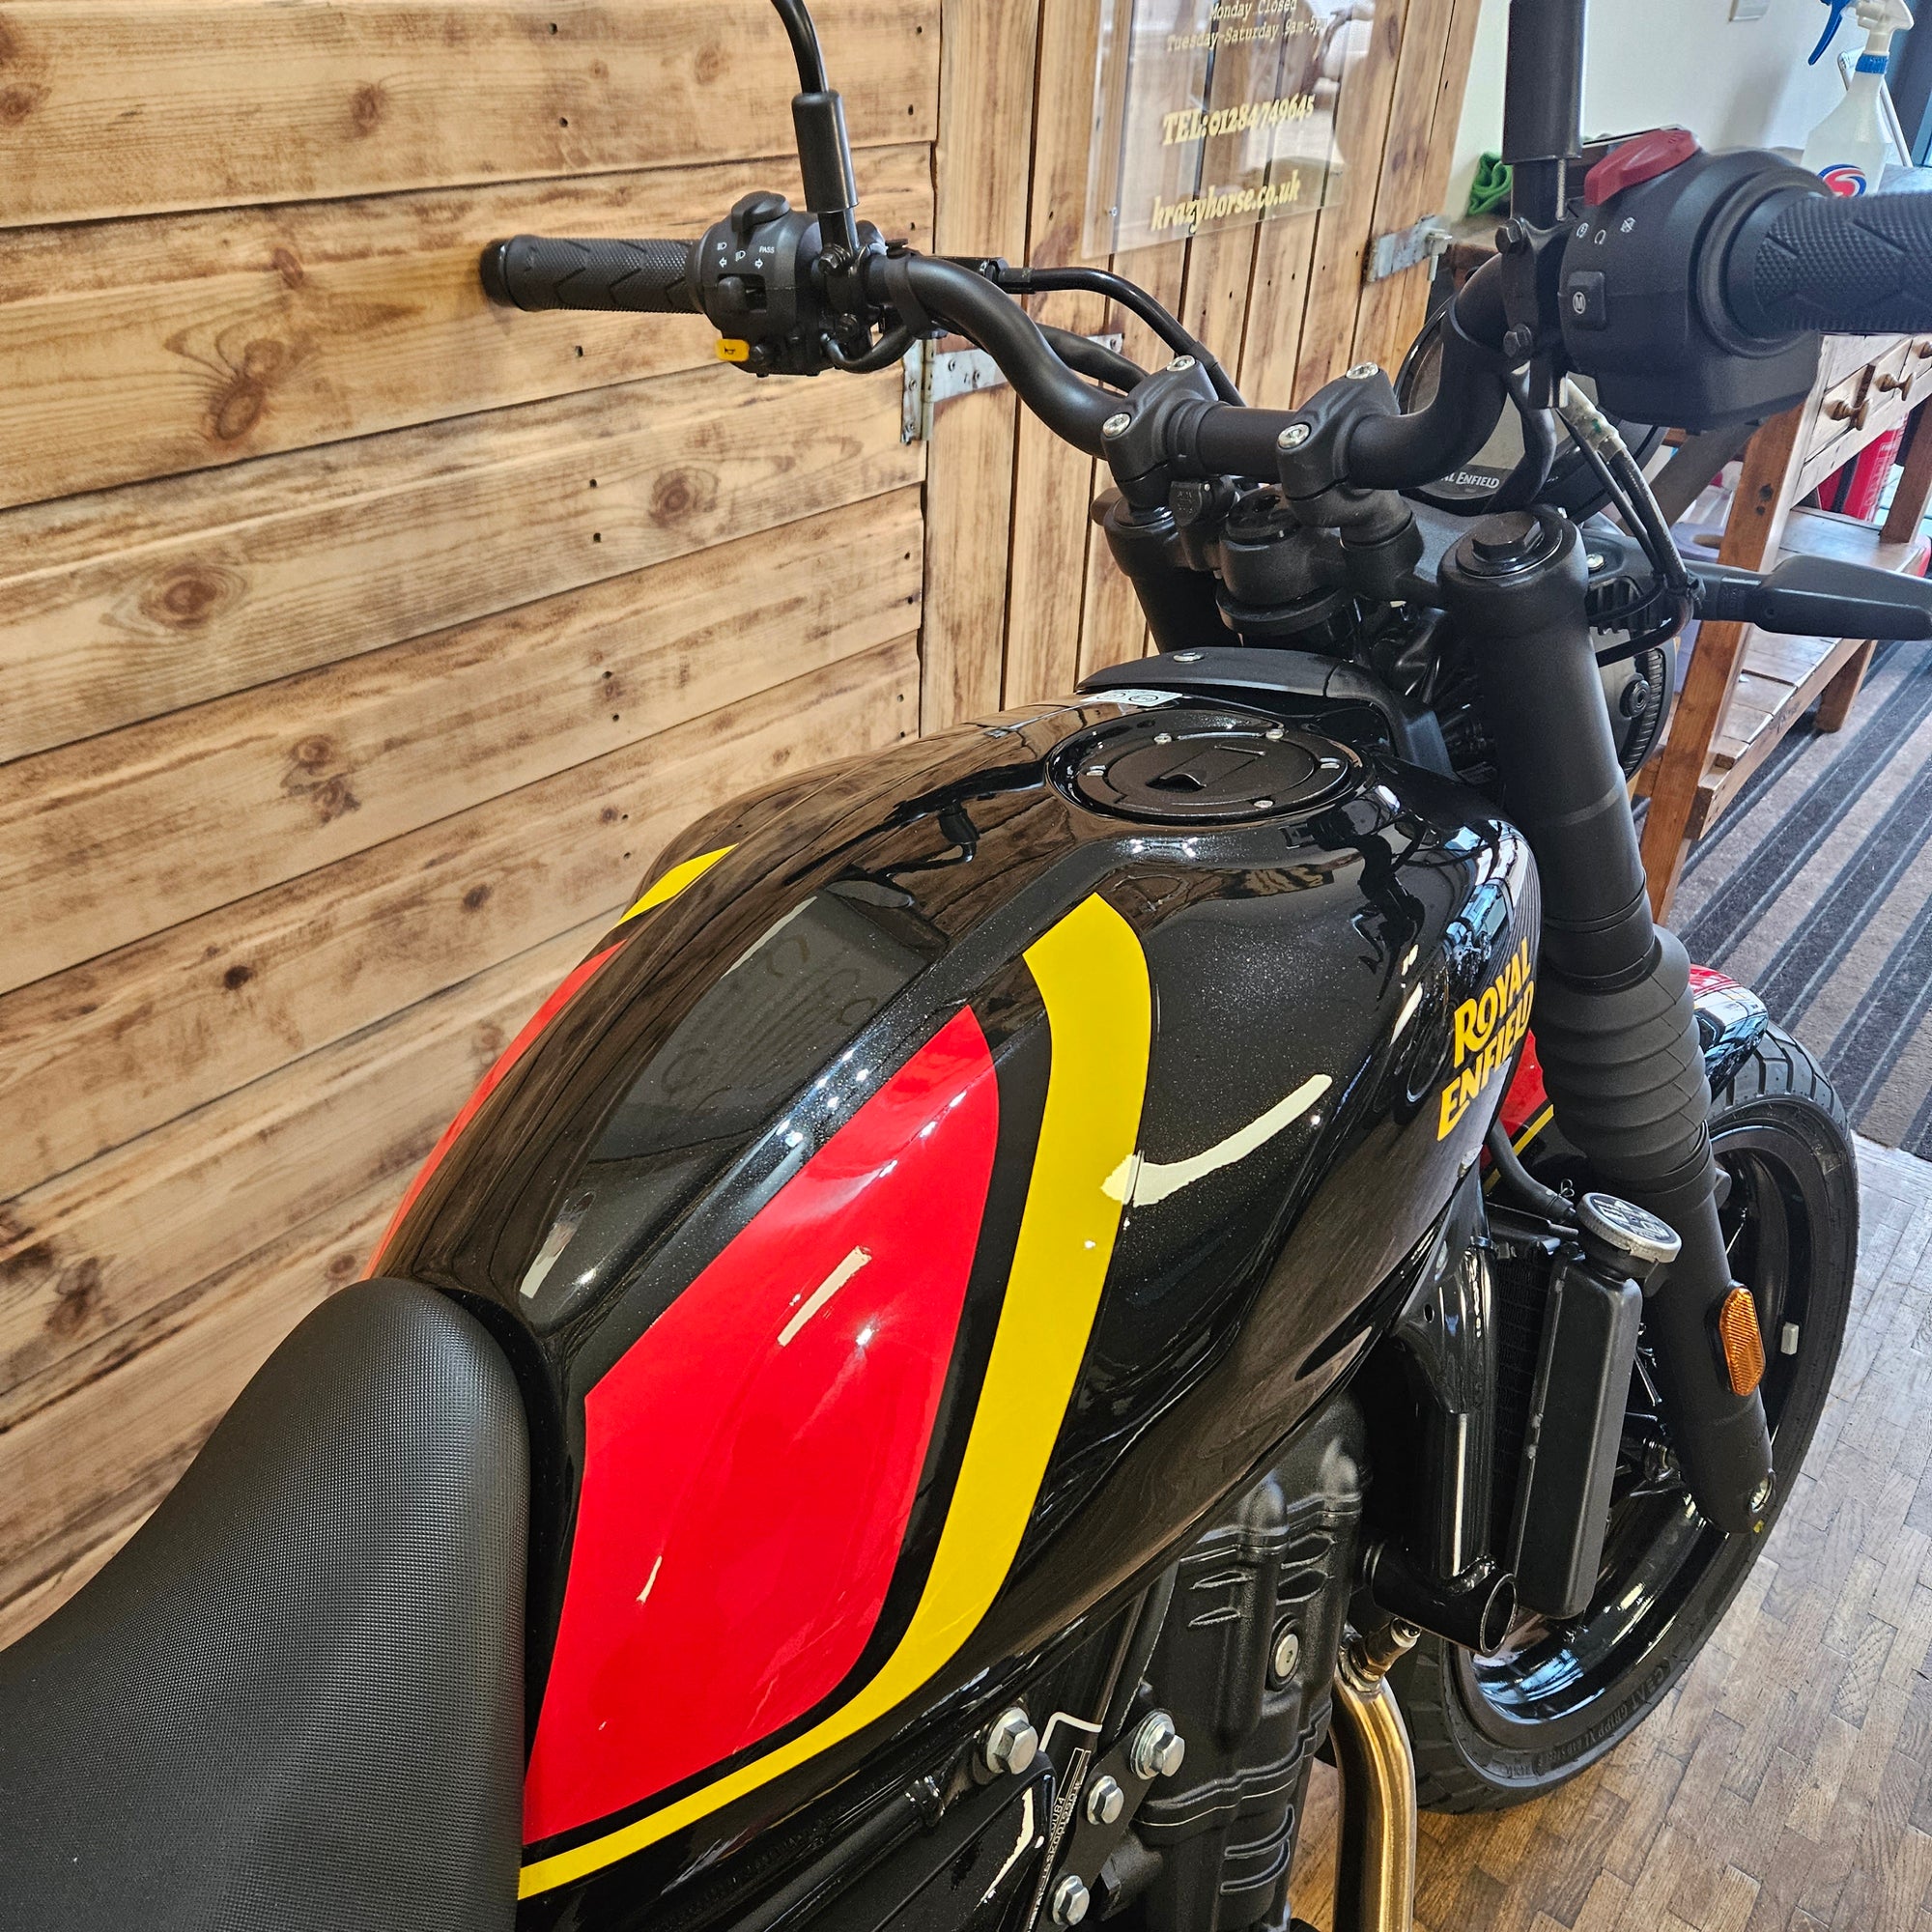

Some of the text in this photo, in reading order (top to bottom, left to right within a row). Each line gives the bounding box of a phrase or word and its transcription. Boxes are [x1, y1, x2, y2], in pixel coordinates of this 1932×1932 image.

[1209, 0, 1297, 23] Monday Closed
[1150, 169, 1301, 233] krazyhorse.co.uk
[758, 245, 775, 254] PASS
[1456, 471, 1500, 489] ENFIELD
[1454, 936, 1531, 1069] ROYAL
[1436, 980, 1535, 1142] ENFIELD
